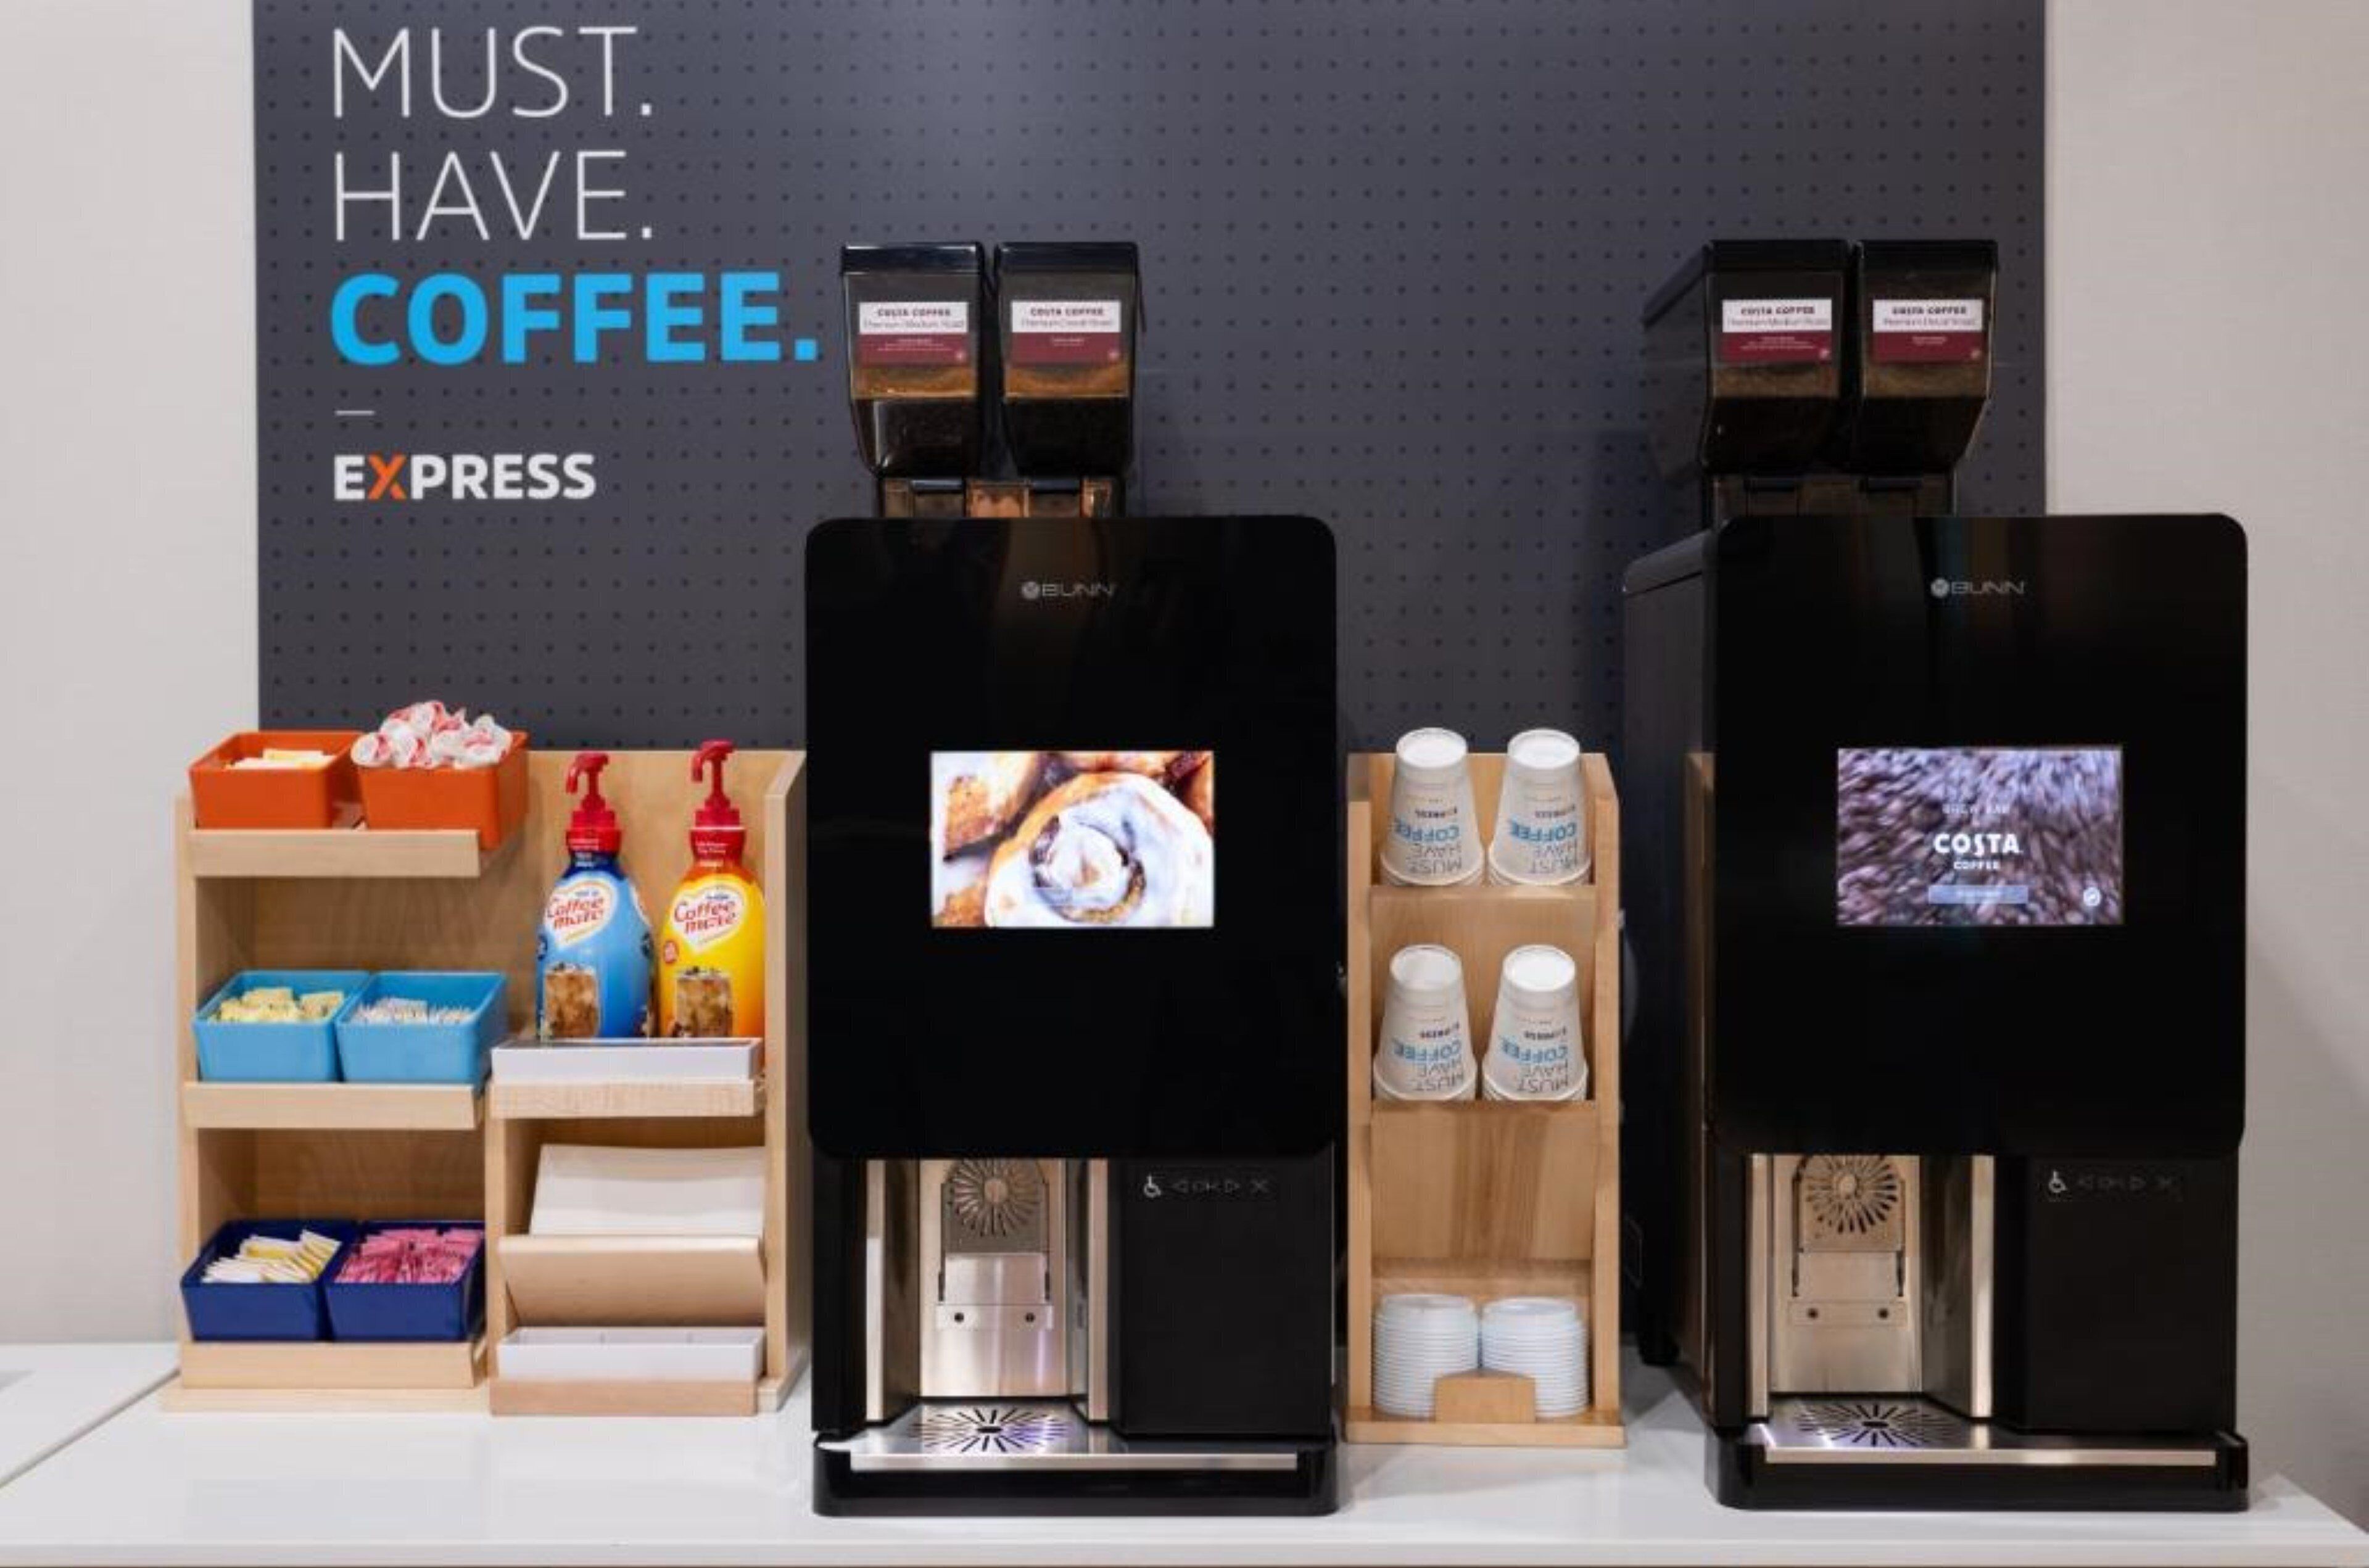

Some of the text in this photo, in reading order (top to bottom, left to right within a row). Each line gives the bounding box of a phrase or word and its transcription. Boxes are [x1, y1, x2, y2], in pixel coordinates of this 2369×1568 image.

[334, 26, 652, 118] MUST.
[336, 151, 653, 241] HAVE.
[330, 271, 817, 367] COFFEE.
[334, 453, 596, 500] EXPRESS
[1951, 580, 2025, 594] BUNN
[1933, 833, 2021, 857] COSTA
[674, 899, 736, 922] Coffee
